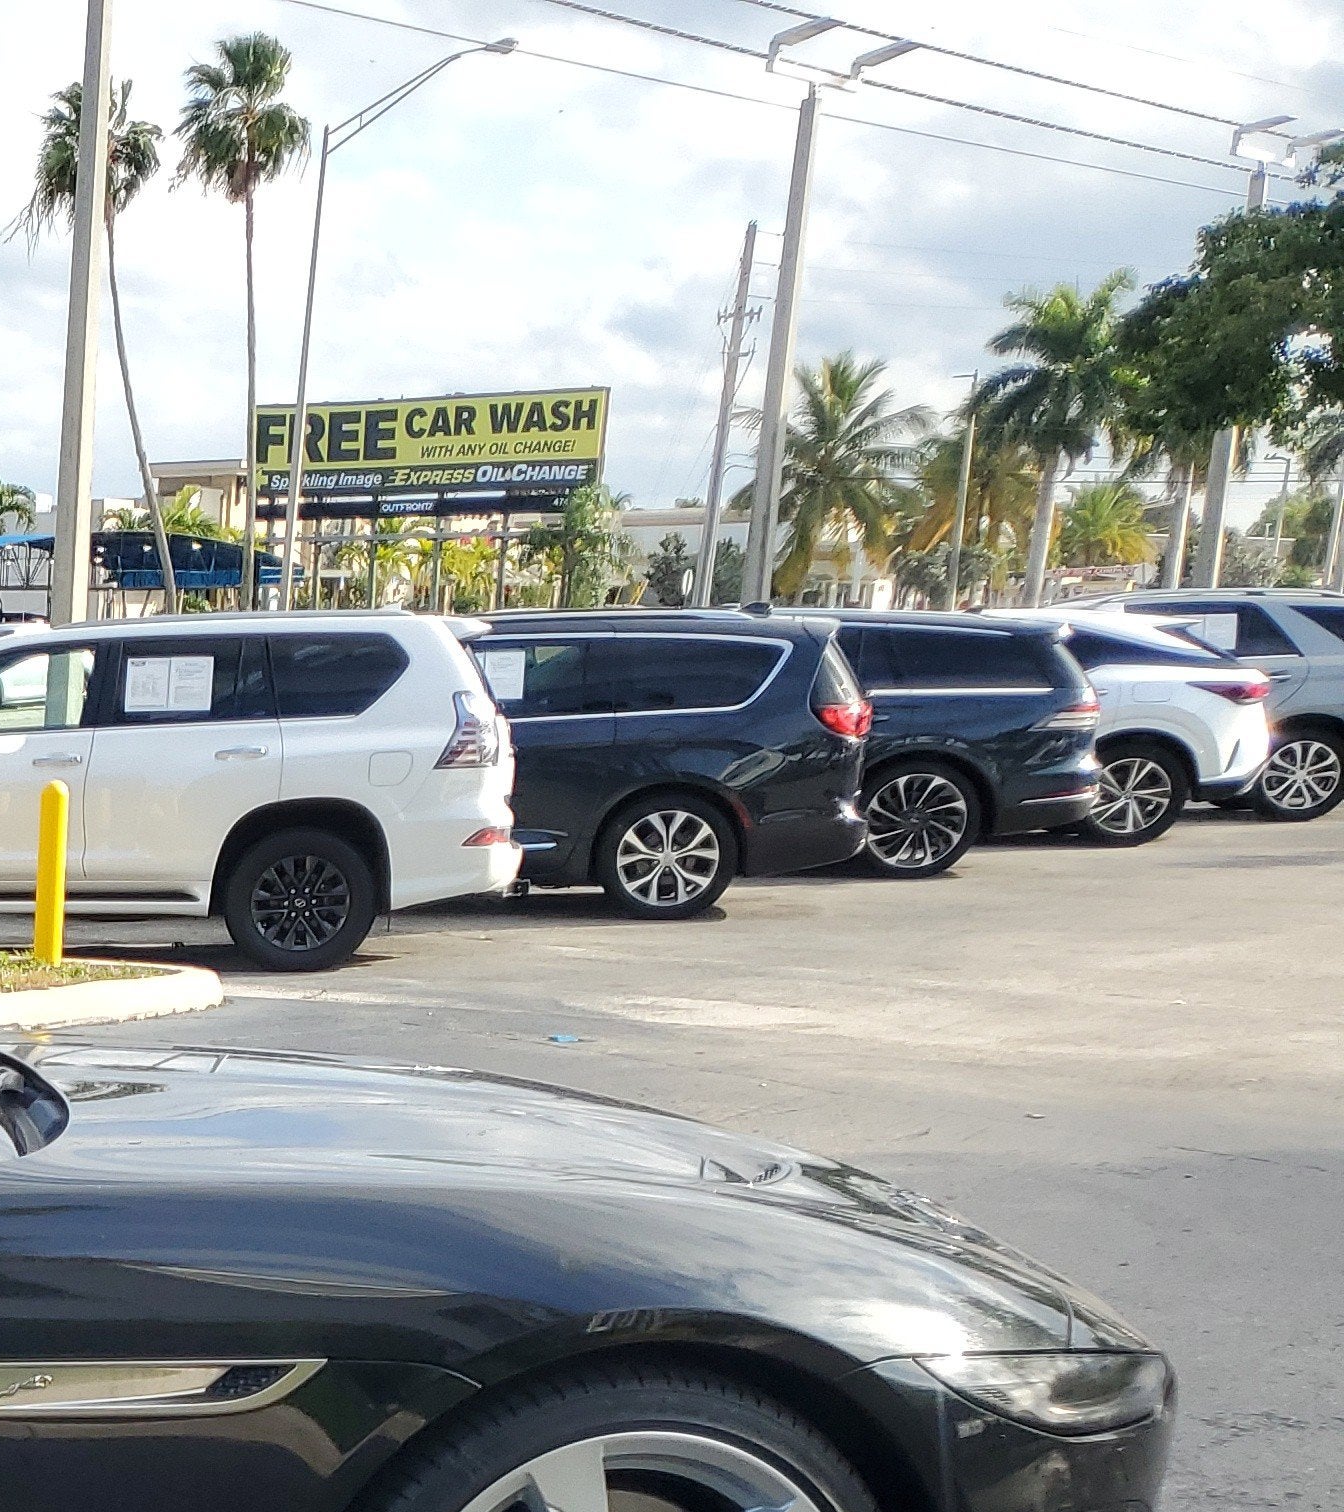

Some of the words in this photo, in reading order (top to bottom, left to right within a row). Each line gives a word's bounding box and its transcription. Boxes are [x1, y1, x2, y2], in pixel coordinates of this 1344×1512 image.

[256, 408, 399, 465] FREE
[404, 404, 477, 439] CAR
[488, 398, 599, 435] WASH
[420, 445, 453, 459] WITH
[456, 443, 486, 457] ANY
[488, 442, 509, 456] OIL
[513, 438, 577, 454] CHANGE!
[270, 472, 336, 490] Spkling
[338, 471, 383, 489] Image
[392, 467, 477, 486] EXPRESS
